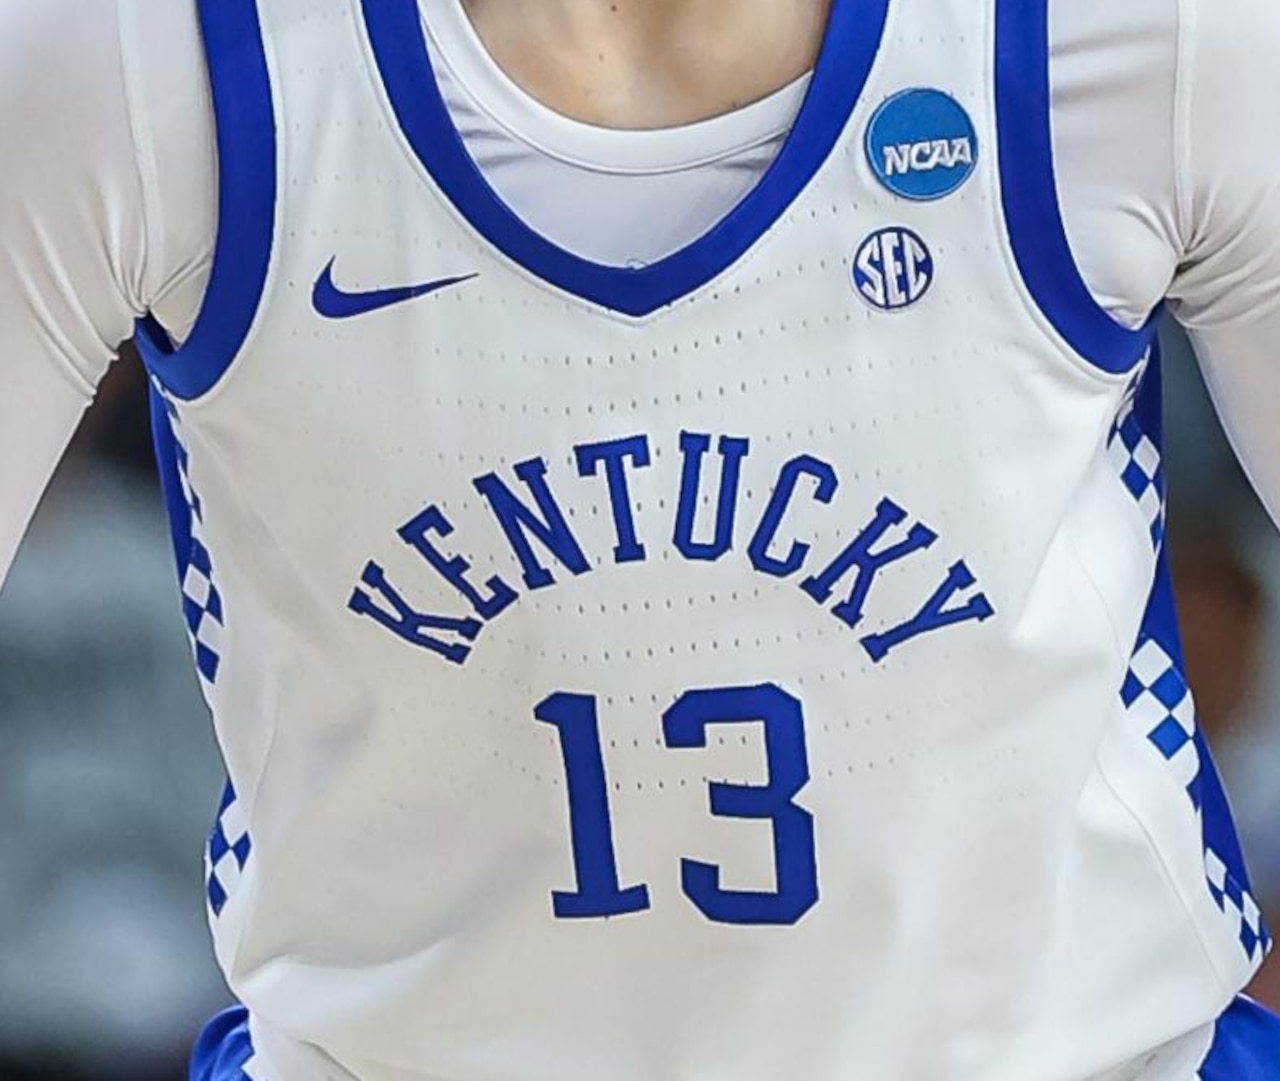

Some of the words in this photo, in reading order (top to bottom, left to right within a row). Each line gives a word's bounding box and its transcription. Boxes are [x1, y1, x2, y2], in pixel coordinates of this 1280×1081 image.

[882, 137, 972, 176] NCAA
[856, 231, 929, 307] SEC
[347, 430, 995, 664] KENTUCKY
[533, 682, 819, 925] 13
